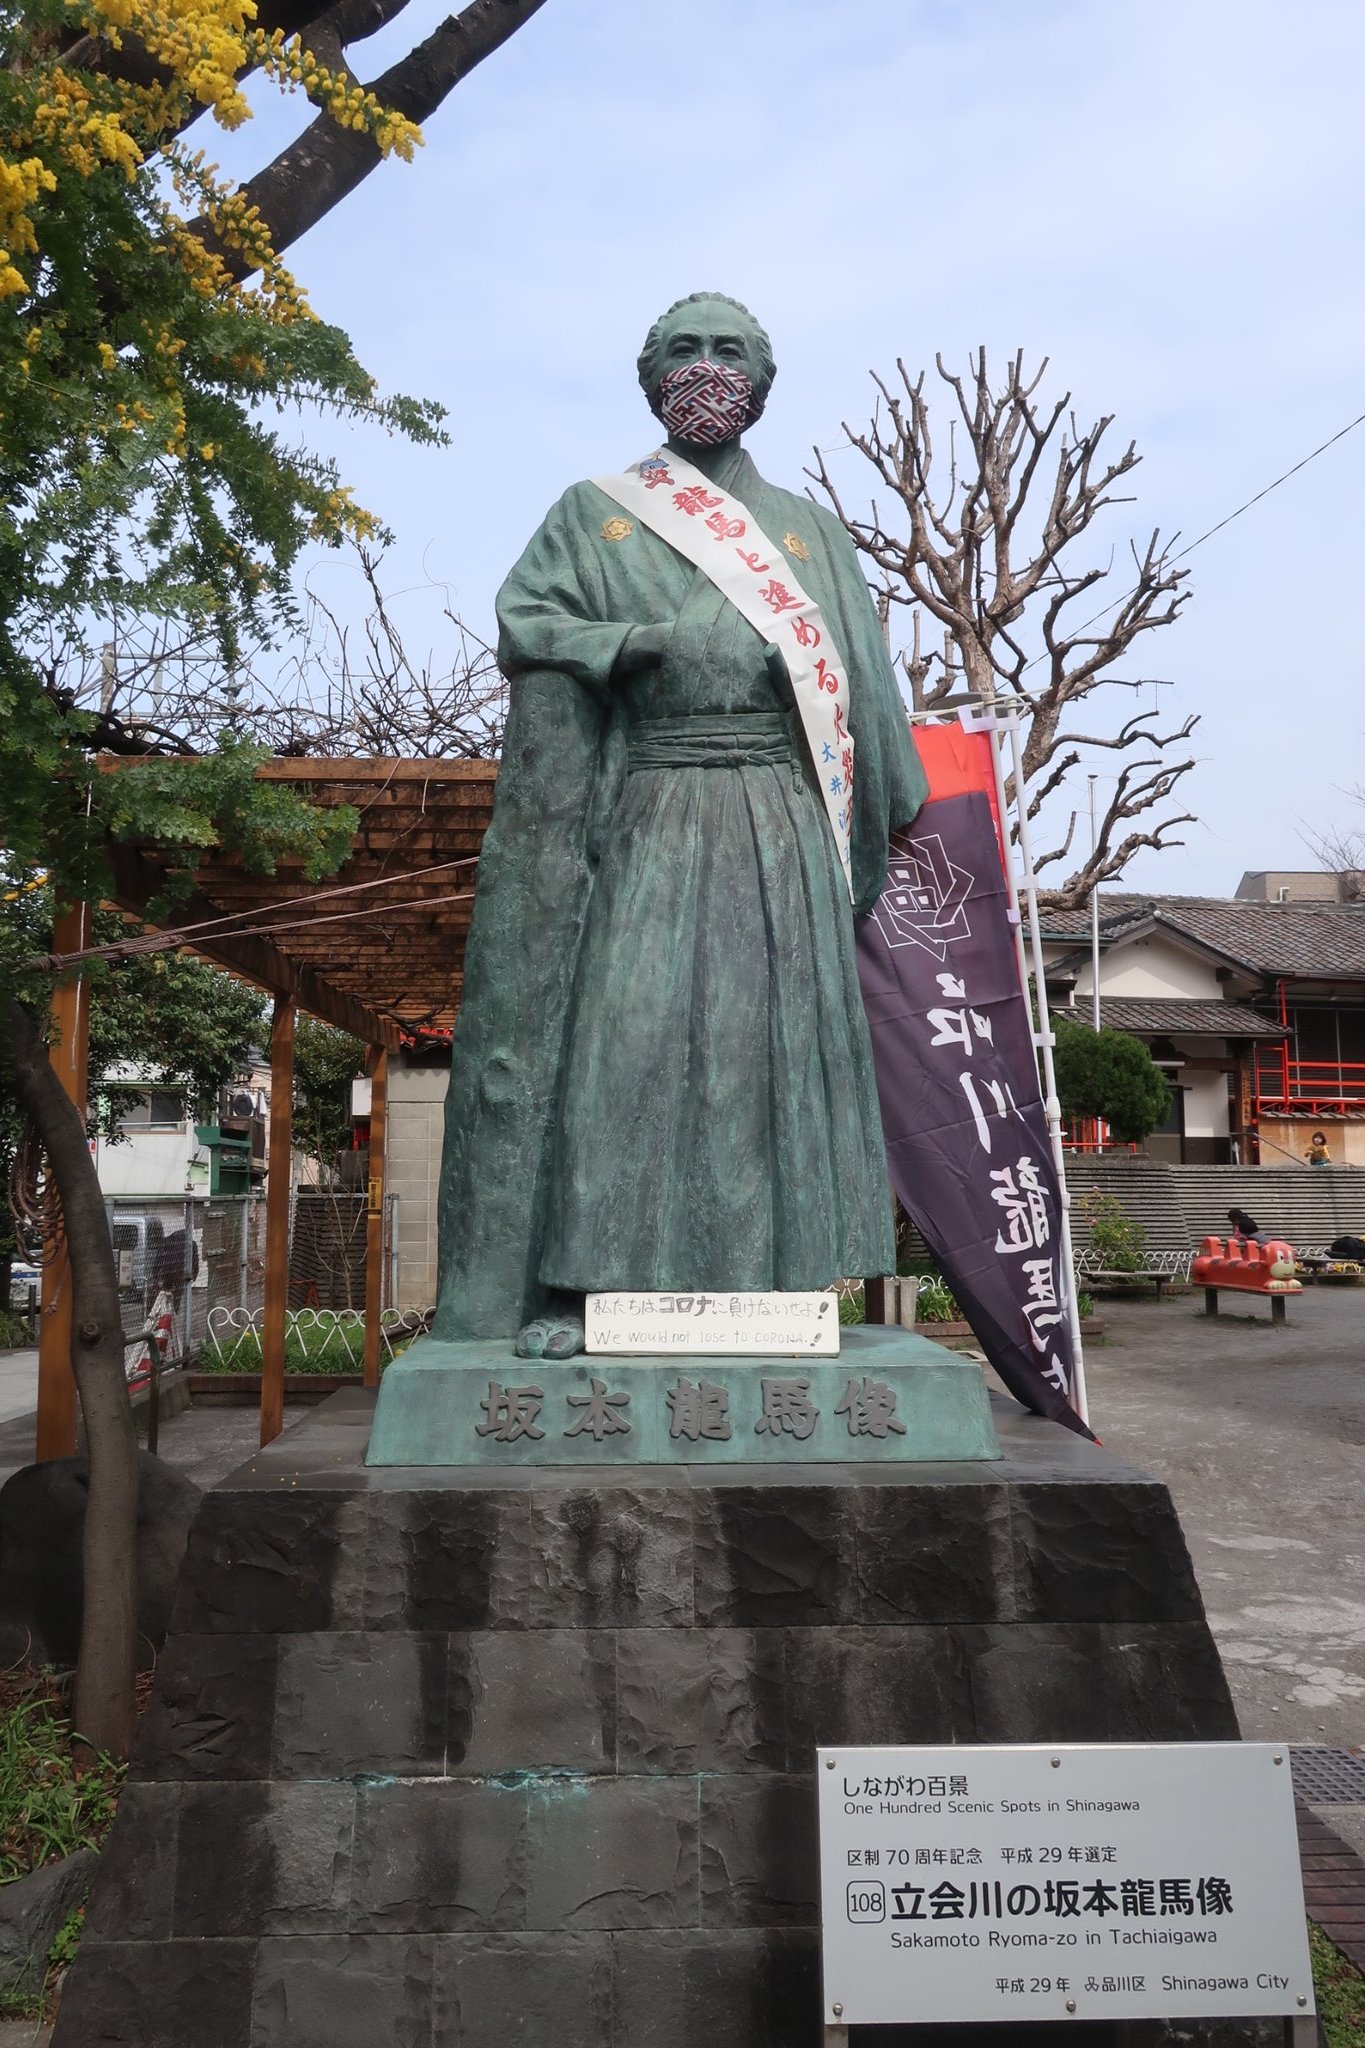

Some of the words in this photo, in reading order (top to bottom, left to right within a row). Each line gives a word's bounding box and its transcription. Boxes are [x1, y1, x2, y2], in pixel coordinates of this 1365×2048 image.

[594, 1329, 621, 1345] We
[628, 1330, 667, 1343] would
[672, 1330, 690, 1343] not
[700, 1330, 727, 1343] lose
[734, 1330, 748, 1344] to
[475, 1376, 907, 1441] 坂本龍馬像
[843, 1775, 969, 1797] しながわ百景
[844, 1802, 873, 1814] One
[880, 1801, 941, 1814] Hundred
[949, 1801, 994, 1813] Scenic
[1000, 1800, 1041, 1814] Spots
[1047, 1800, 1060, 1812] in
[1066, 1799, 1140, 1812] Shinagawa
[850, 1893, 882, 1912] 108
[891, 1876, 1234, 1919] 立会川の坂本龍馬像
[891, 1932, 980, 1948] Sakamoto
[989, 1930, 1077, 1948] Ryoma-zo
[1086, 1930, 1100, 1945] in
[1109, 1928, 1217, 1945] Tachiaigawa
[1102, 1976, 1146, 1992] 品川区
[1161, 1975, 1249, 1991] Shinagawa
[1256, 1973, 1289, 1990] City
